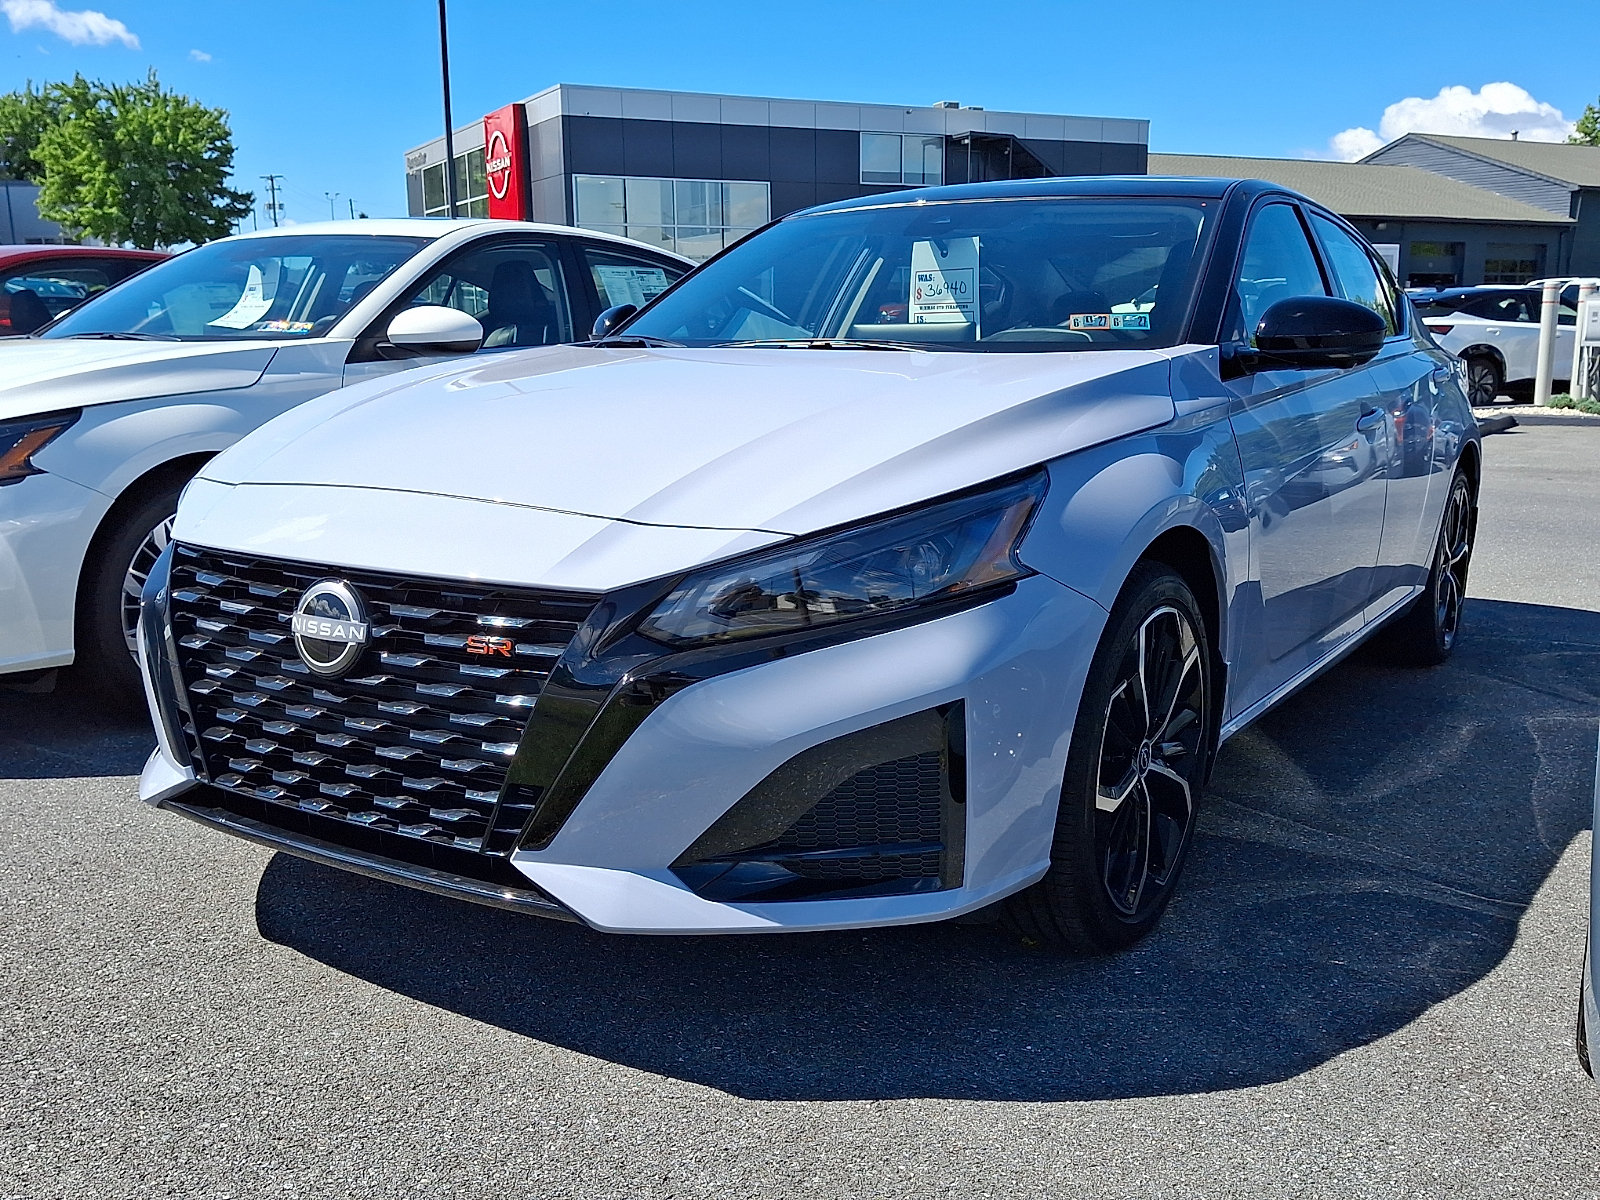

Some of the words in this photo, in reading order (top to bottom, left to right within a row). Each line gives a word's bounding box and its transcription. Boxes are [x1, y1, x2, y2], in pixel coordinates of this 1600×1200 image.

[486, 156, 511, 174] NISSAN
[916, 287, 922, 300] $
[925, 280, 967, 297] 36940
[1098, 315, 1107, 327] 27
[1138, 315, 1147, 327] 27
[292, 616, 364, 640] NISSAN
[467, 635, 512, 657] SR
